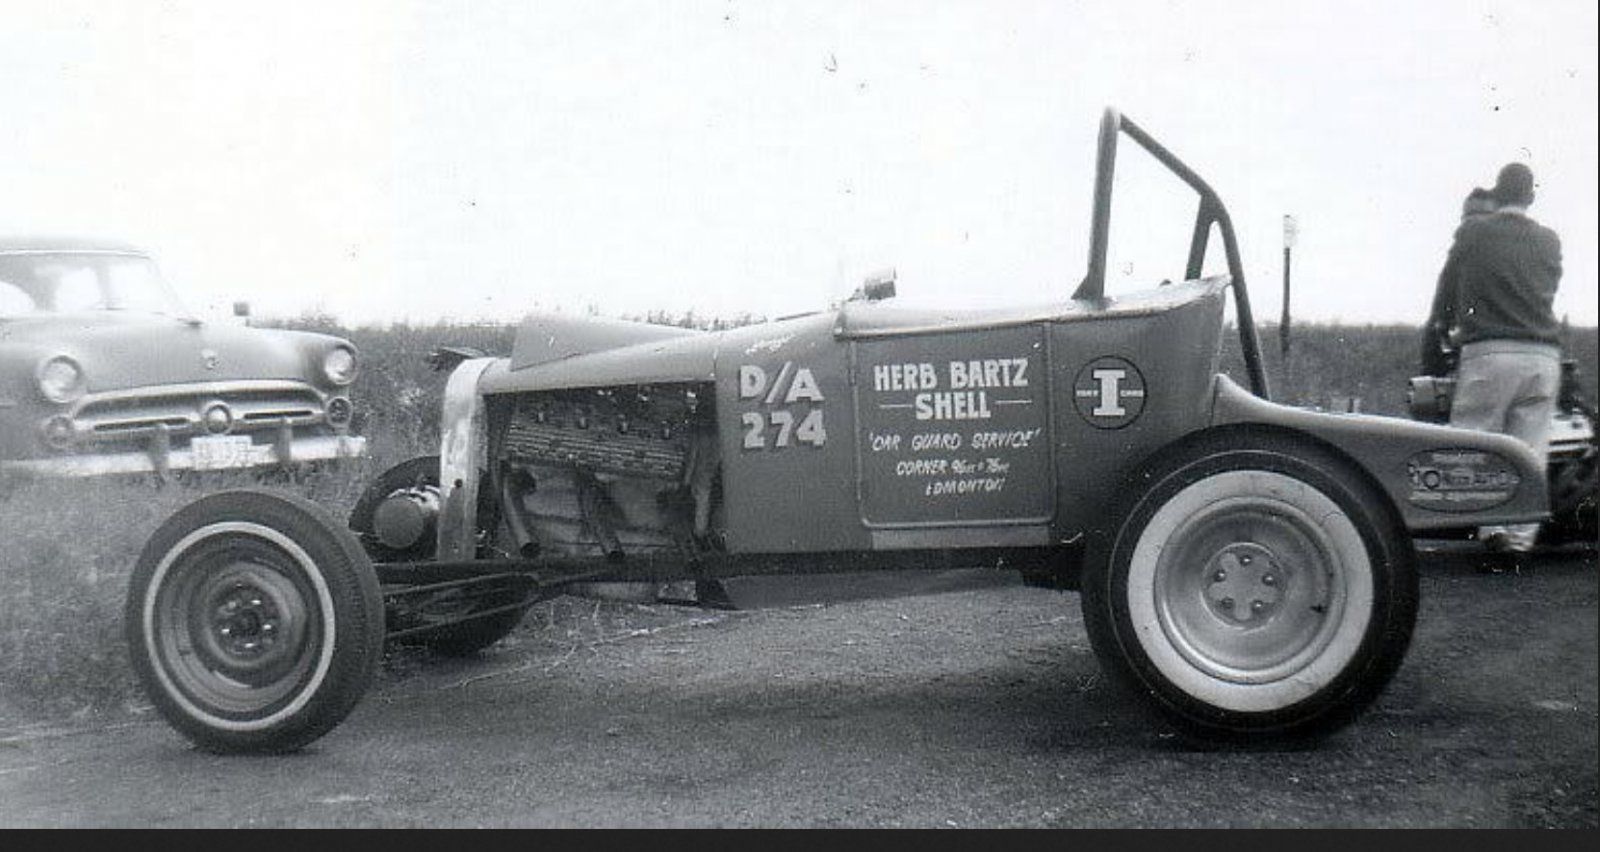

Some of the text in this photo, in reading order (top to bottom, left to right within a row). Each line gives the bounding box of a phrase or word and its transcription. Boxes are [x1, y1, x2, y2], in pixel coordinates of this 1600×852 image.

[740, 360, 825, 403] D/A
[873, 357, 1029, 392] HERB BARTZ
[915, 391, 991, 420] SHELL
[741, 409, 827, 449] 274
[911, 433, 961, 450] GUARD
[896, 459, 949, 476] CORNER
